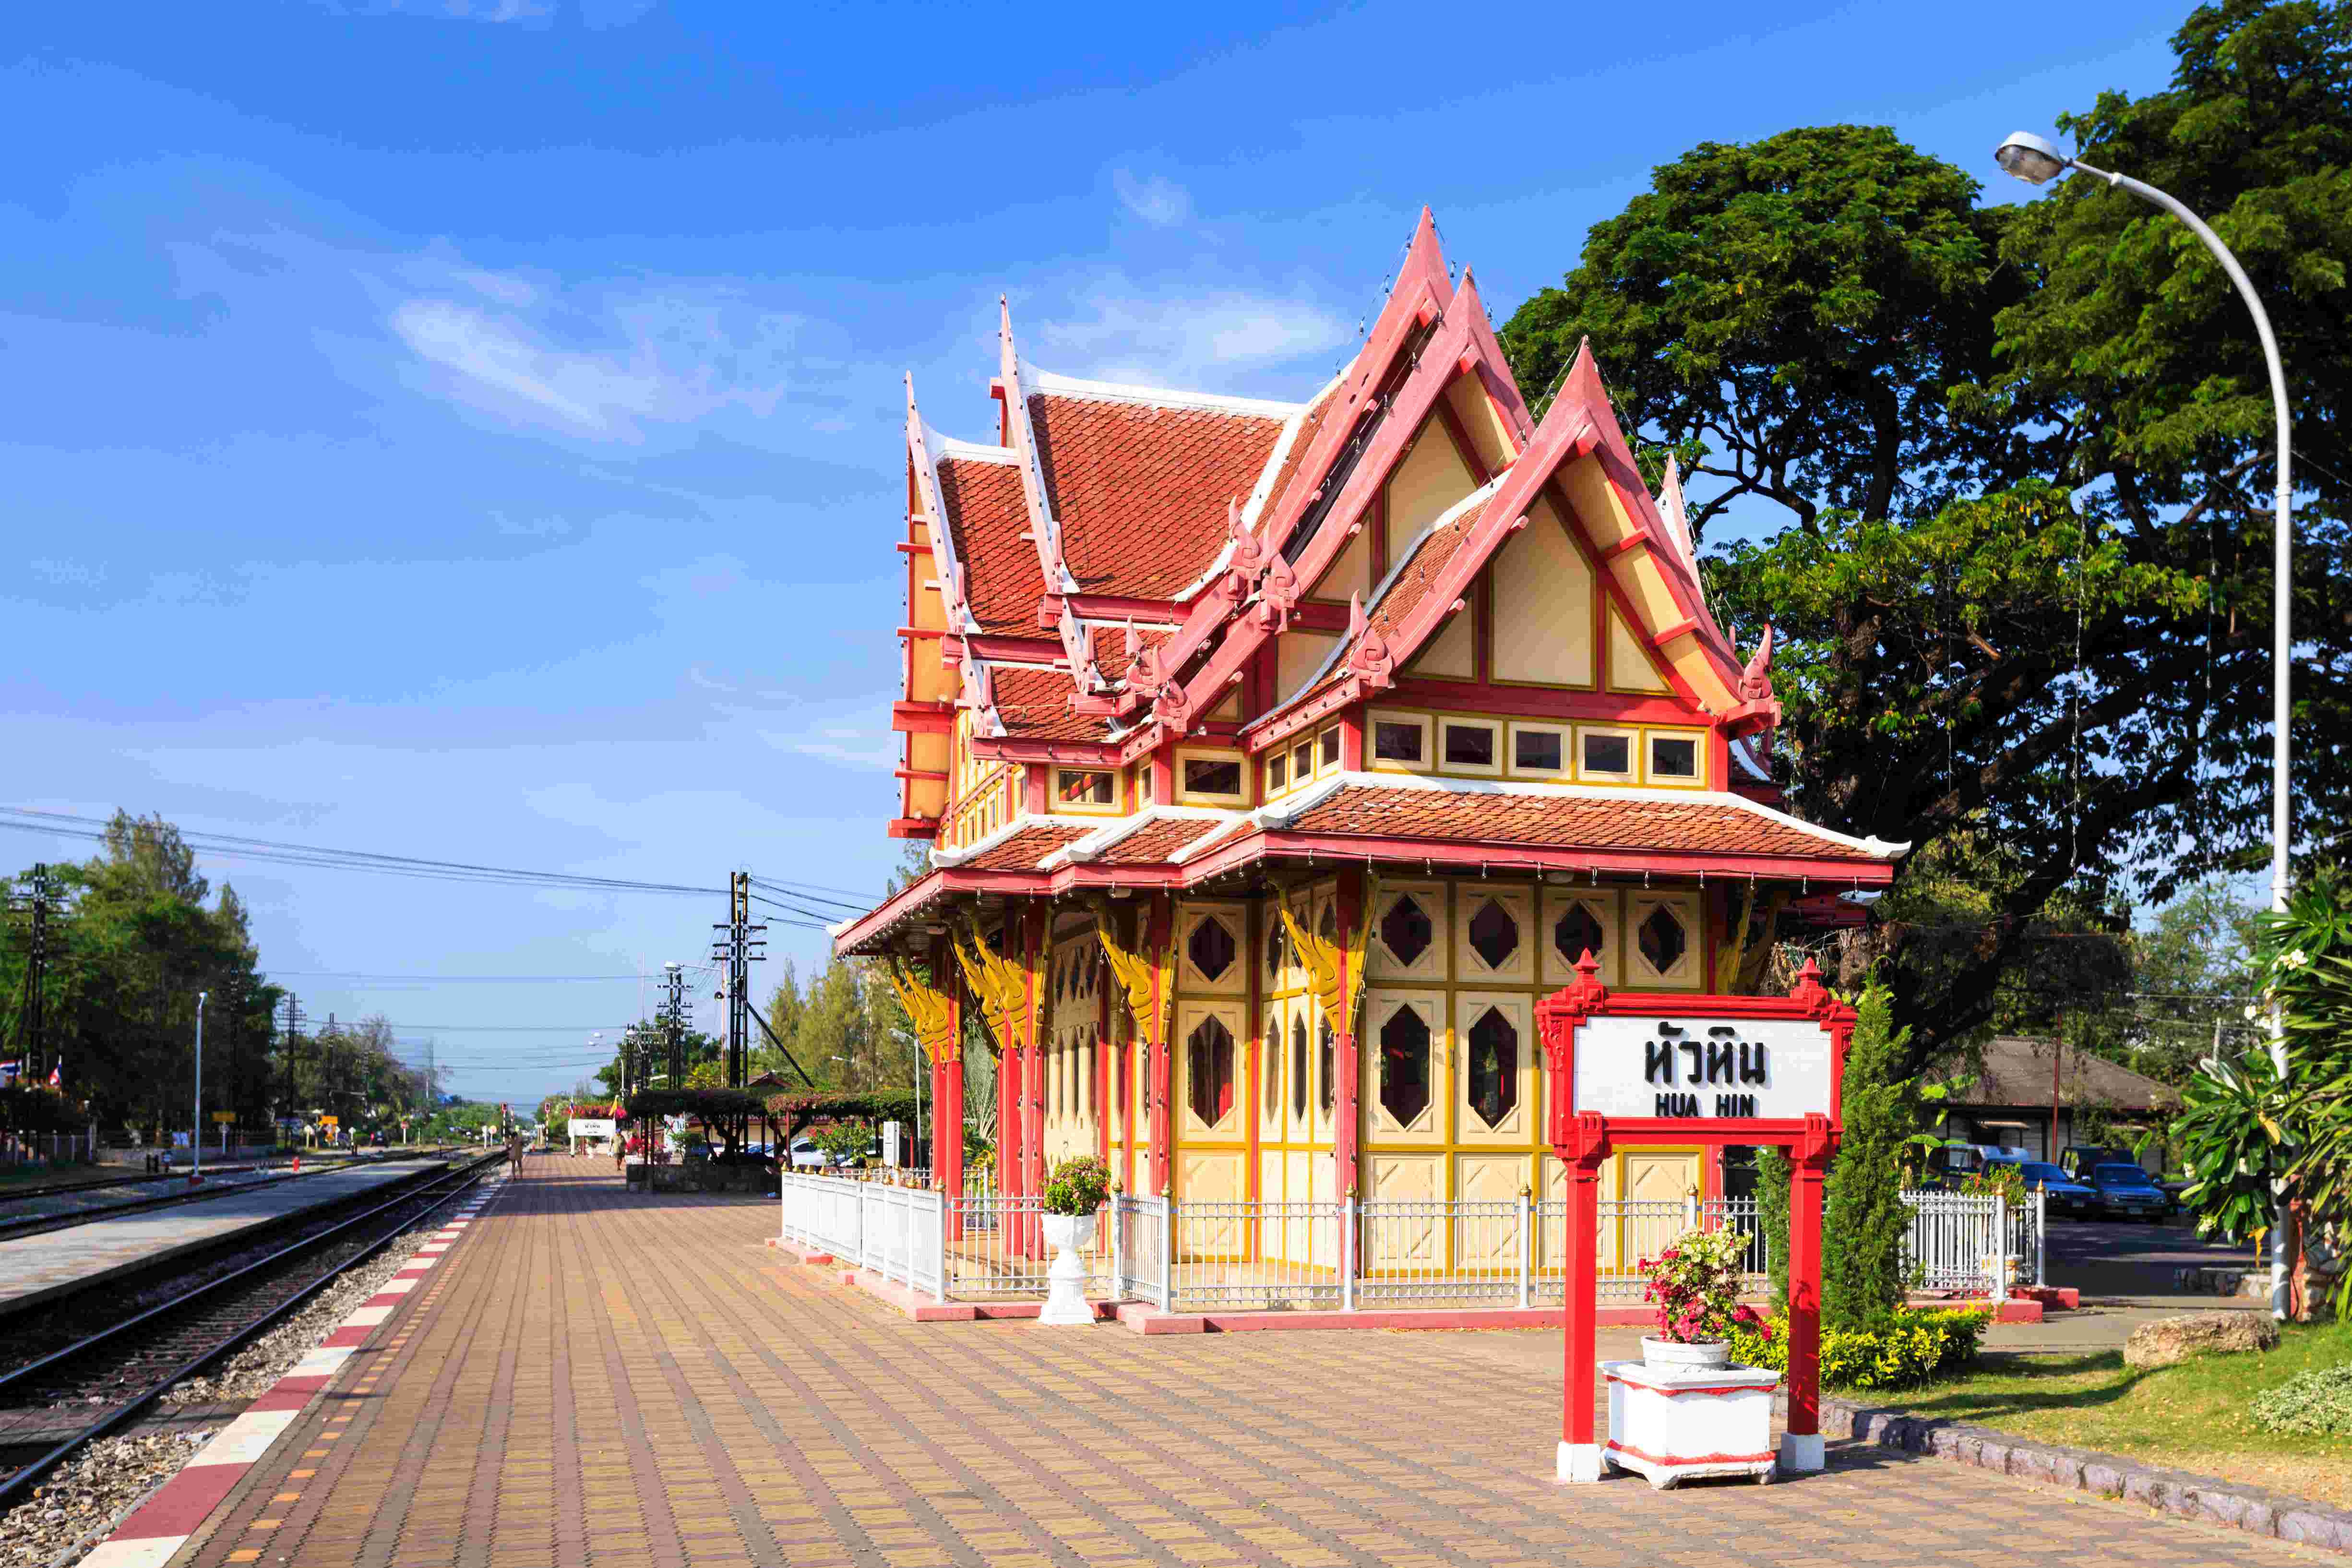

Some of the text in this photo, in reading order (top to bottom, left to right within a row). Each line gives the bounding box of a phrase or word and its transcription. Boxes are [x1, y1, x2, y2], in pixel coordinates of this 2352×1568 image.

[1644, 1021, 1766, 1084] หัวหิน
[1655, 1092, 1754, 1118] HUA HIN
